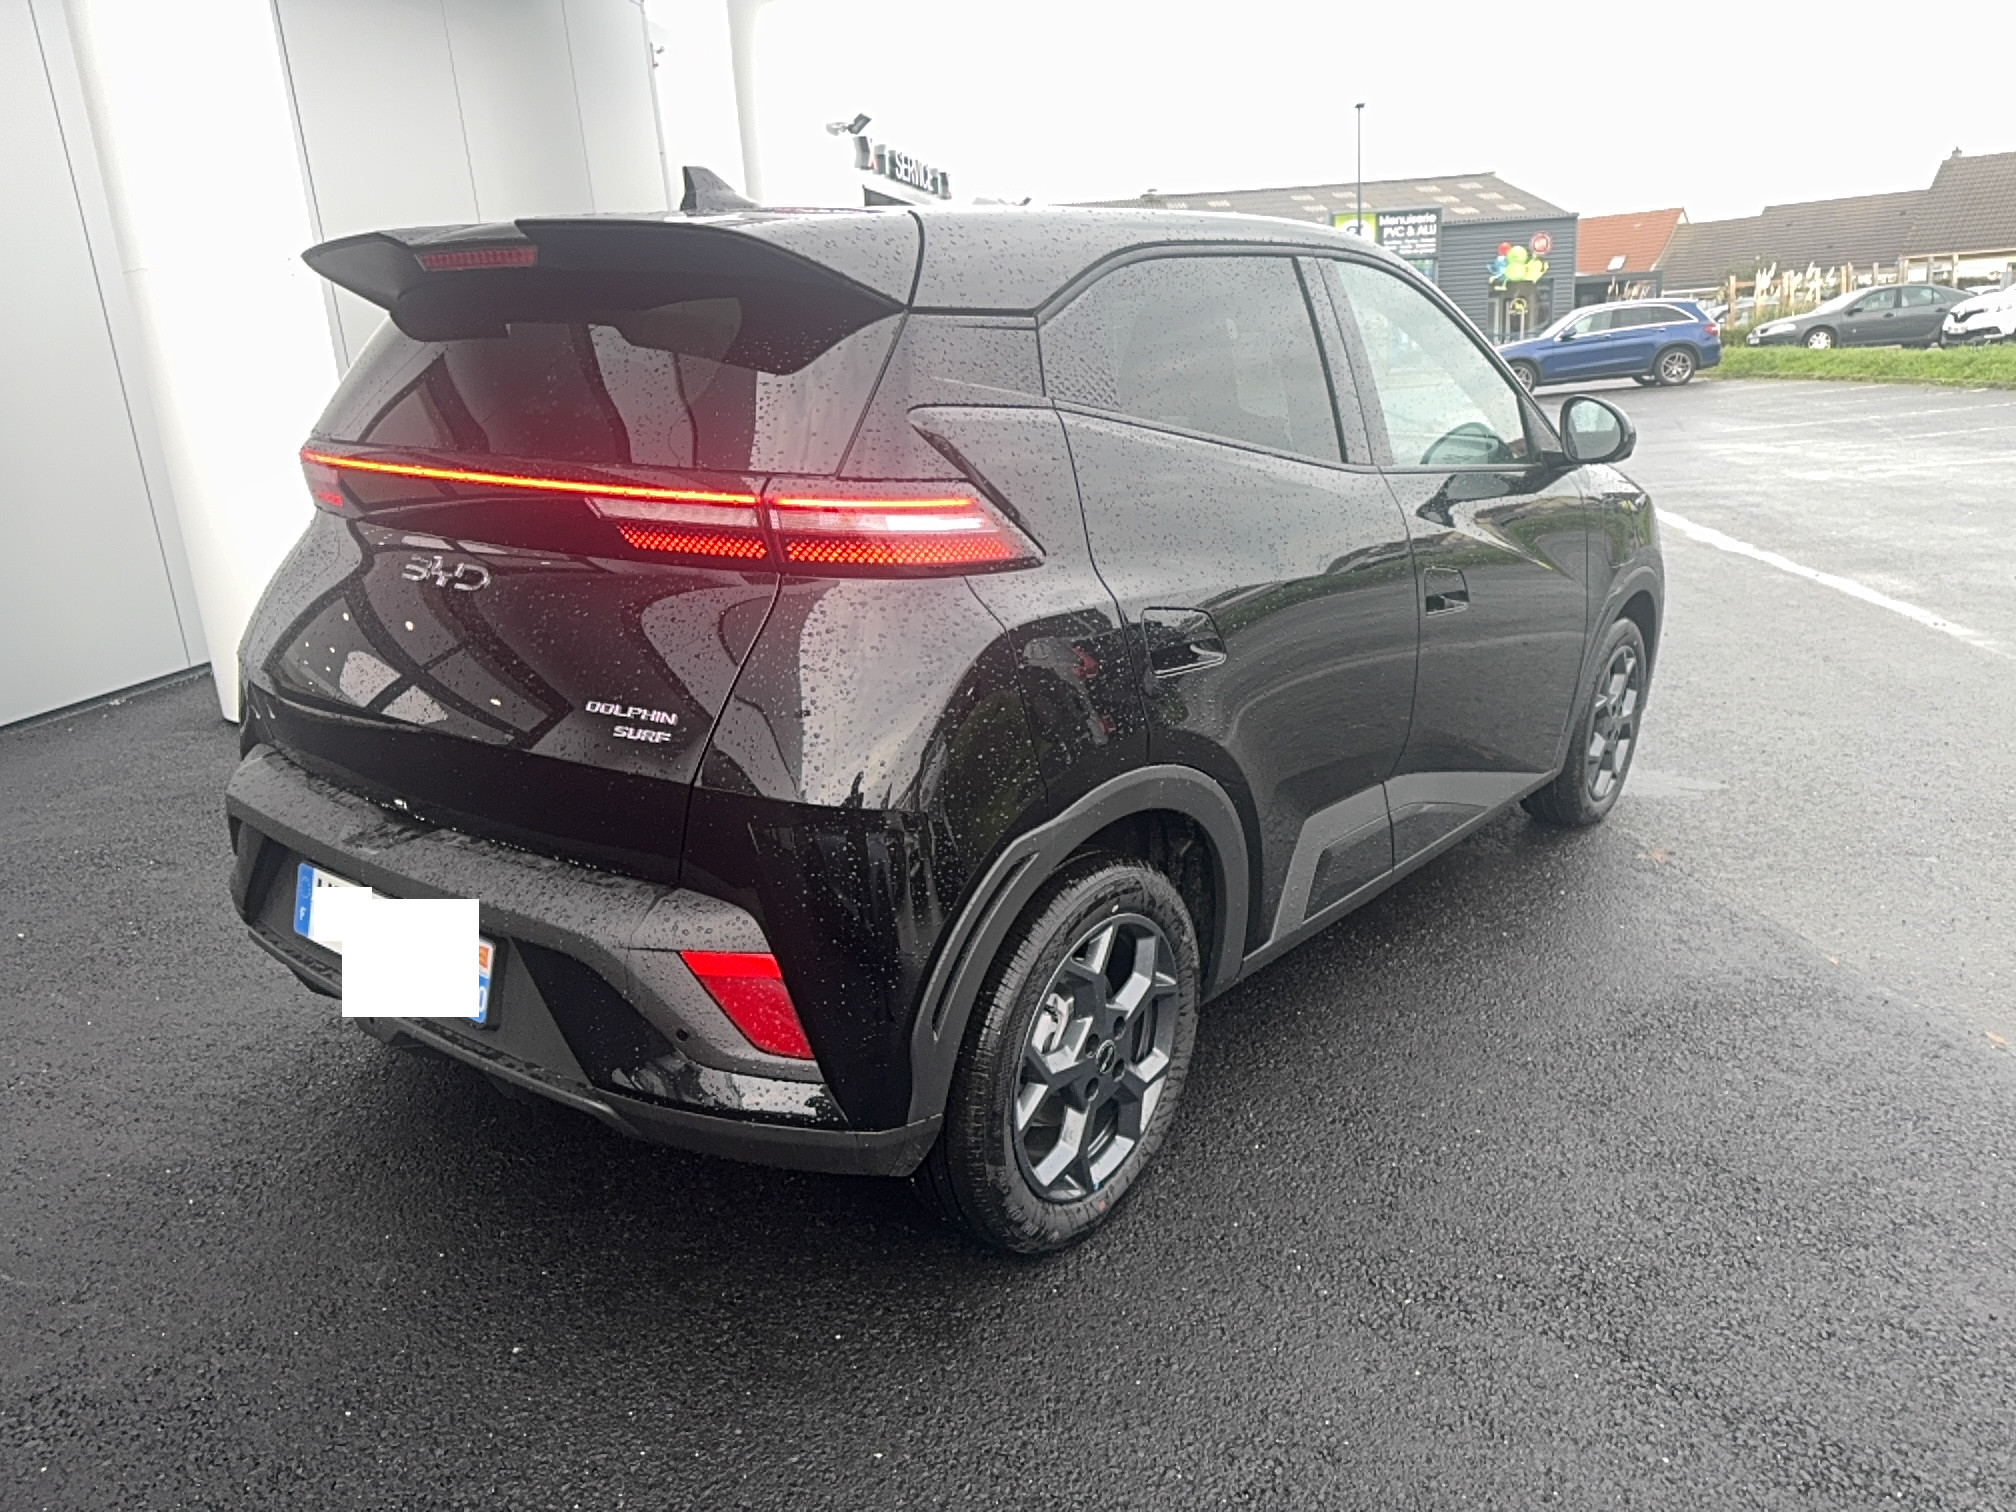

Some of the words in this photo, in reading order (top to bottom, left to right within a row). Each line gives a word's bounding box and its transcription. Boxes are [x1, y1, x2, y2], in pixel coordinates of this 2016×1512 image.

[895, 152, 933, 191] SERVICE
[1379, 213, 1437, 226] Menuiserie
[1383, 226, 1405, 238] PVC
[1416, 223, 1437, 236] ALU
[585, 700, 678, 726] DOLPHIN
[612, 725, 672, 743] SURF
[299, 906, 307, 921] F
